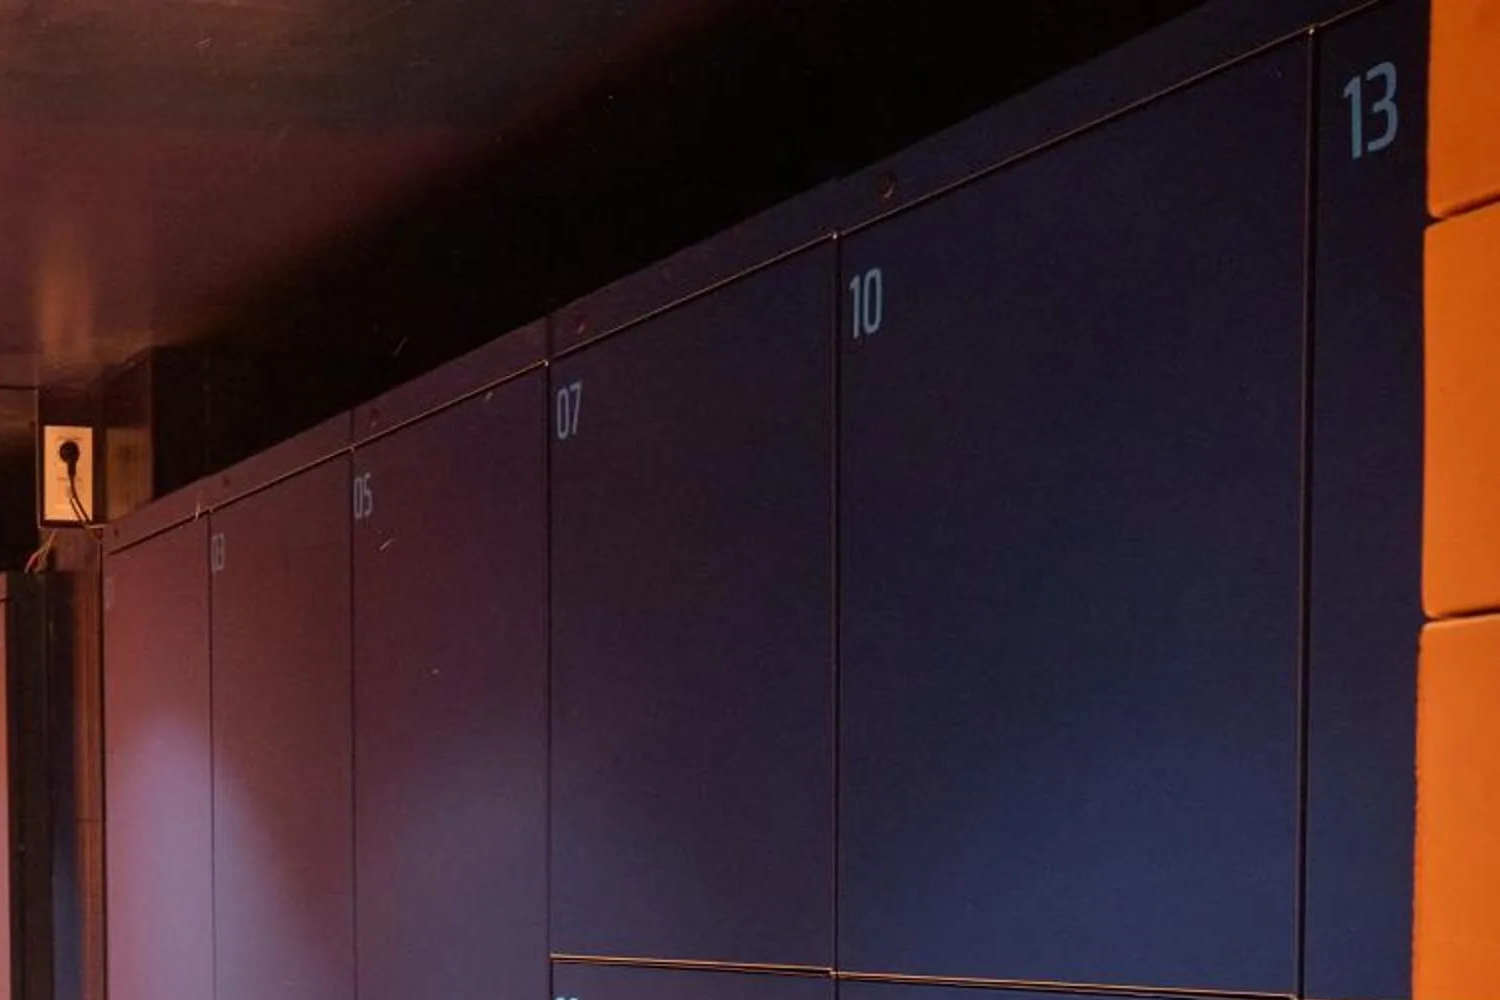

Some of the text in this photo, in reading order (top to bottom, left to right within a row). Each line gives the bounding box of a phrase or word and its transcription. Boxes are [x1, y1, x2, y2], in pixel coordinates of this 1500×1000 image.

[1342, 60, 1398, 159] 13
[848, 267, 883, 340] 10
[555, 382, 583, 439] 07
[353, 472, 373, 519] 05
